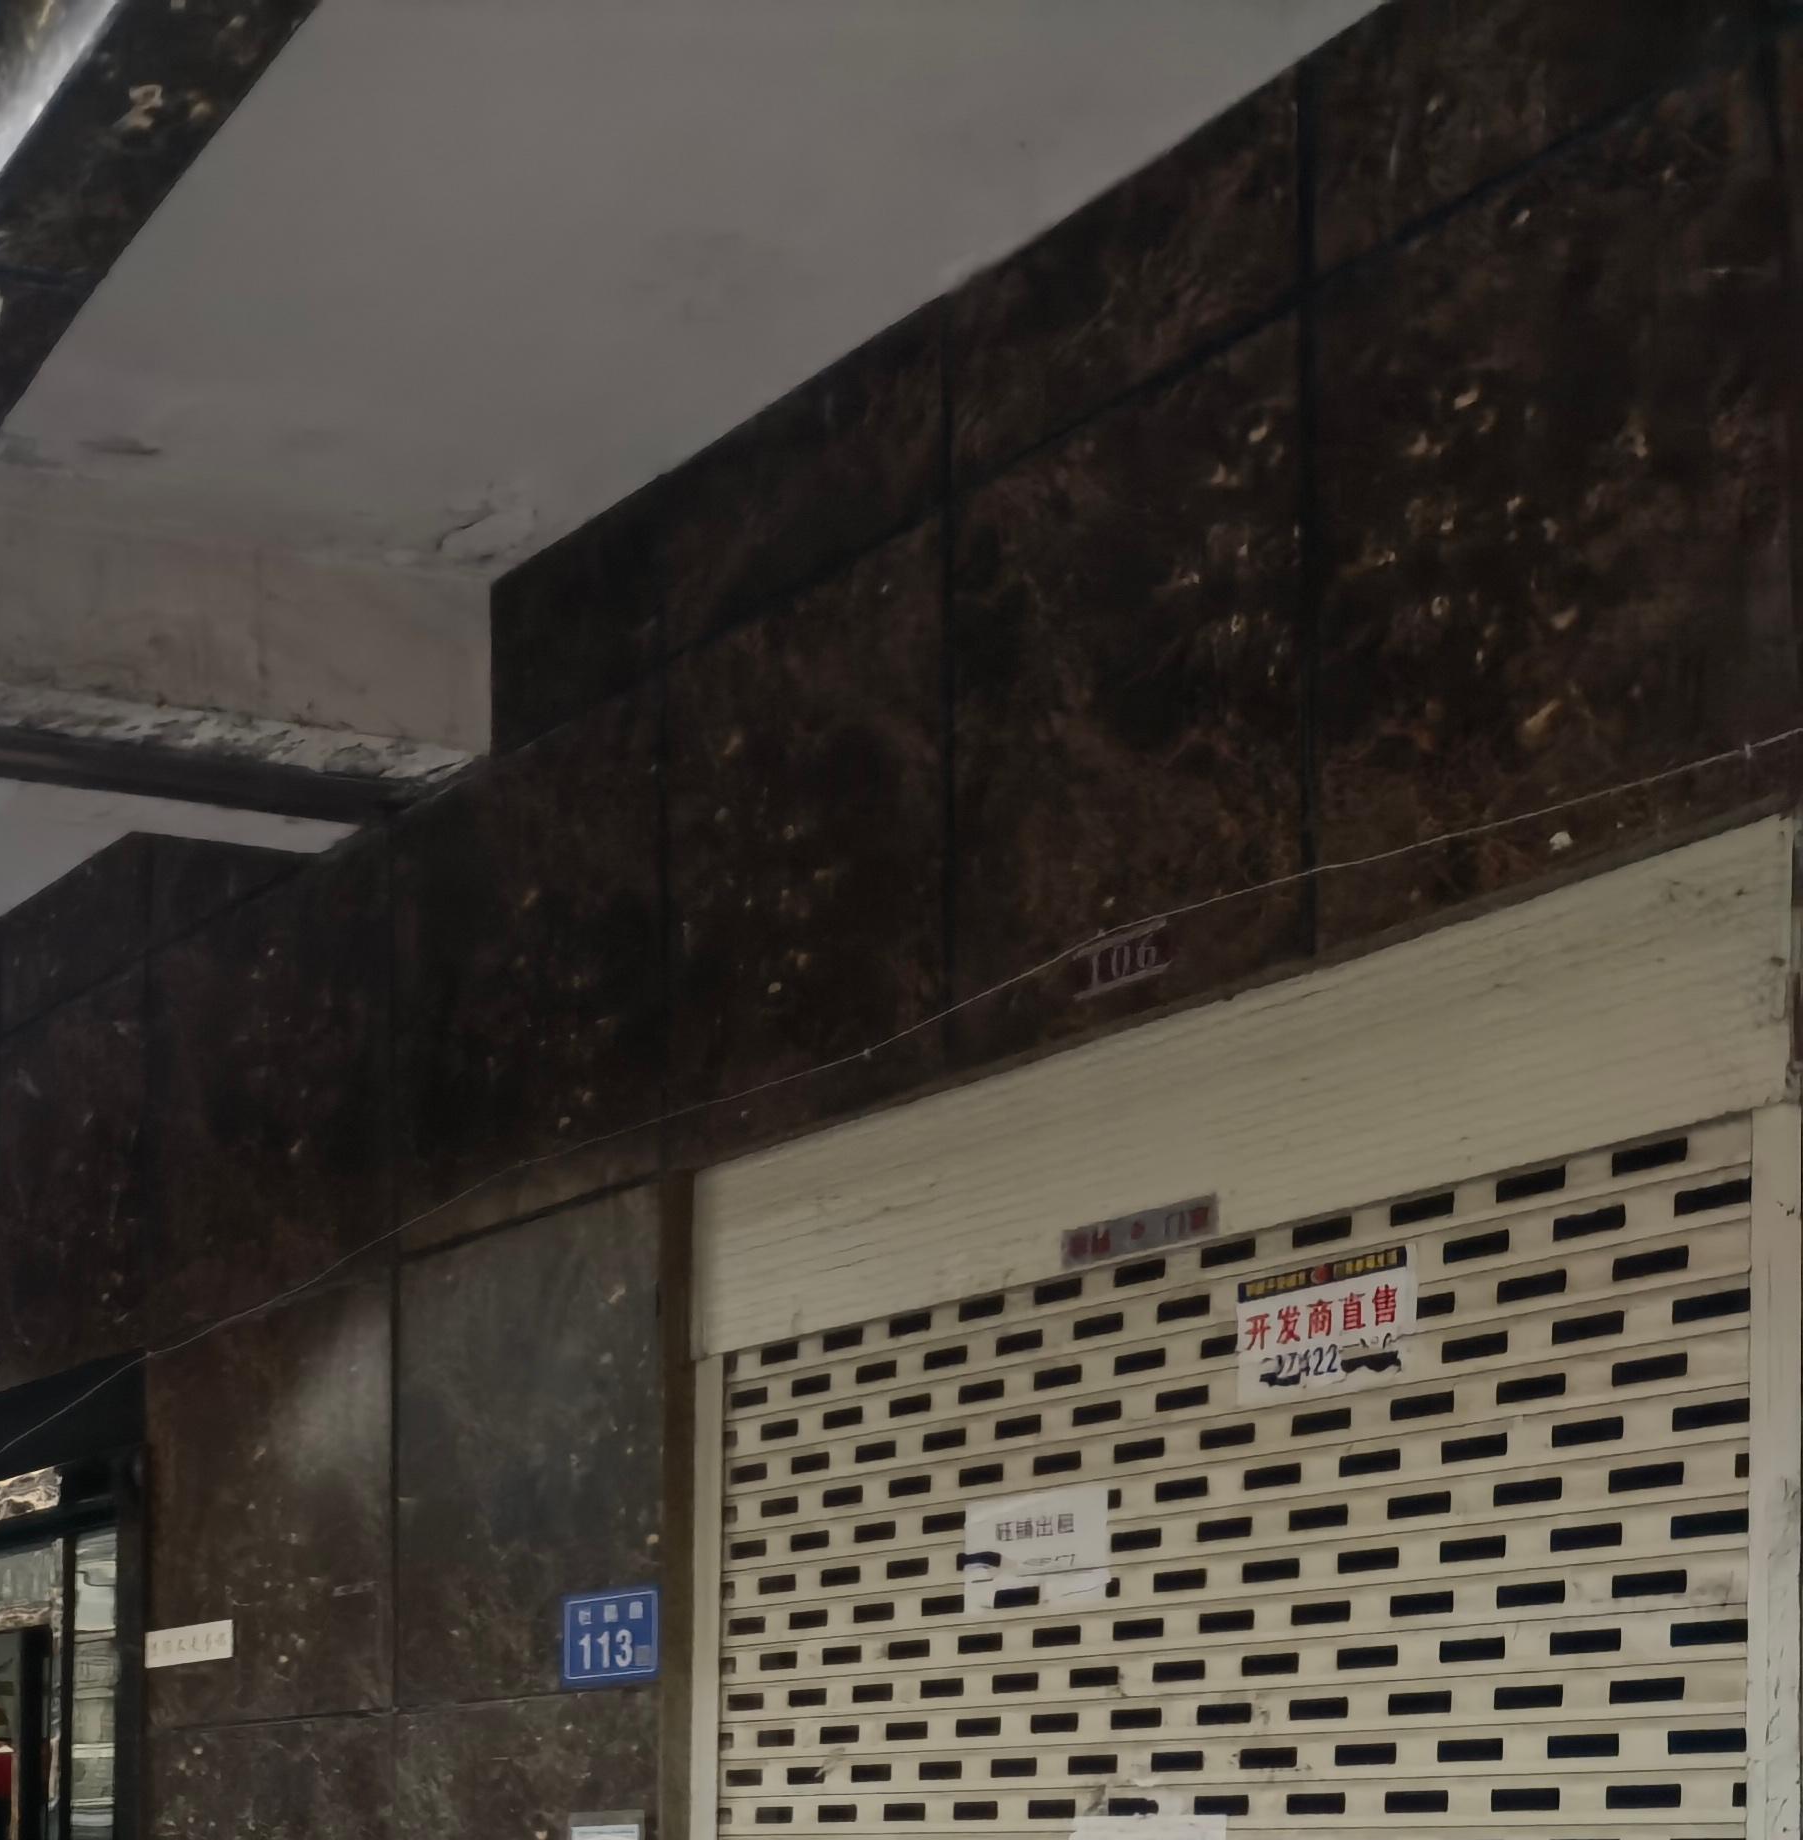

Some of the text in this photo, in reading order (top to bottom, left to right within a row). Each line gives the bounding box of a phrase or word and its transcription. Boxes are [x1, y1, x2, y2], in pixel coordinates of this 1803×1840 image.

[1244, 1284, 1398, 1351] 开发商直售
[579, 1629, 633, 1670] 113
